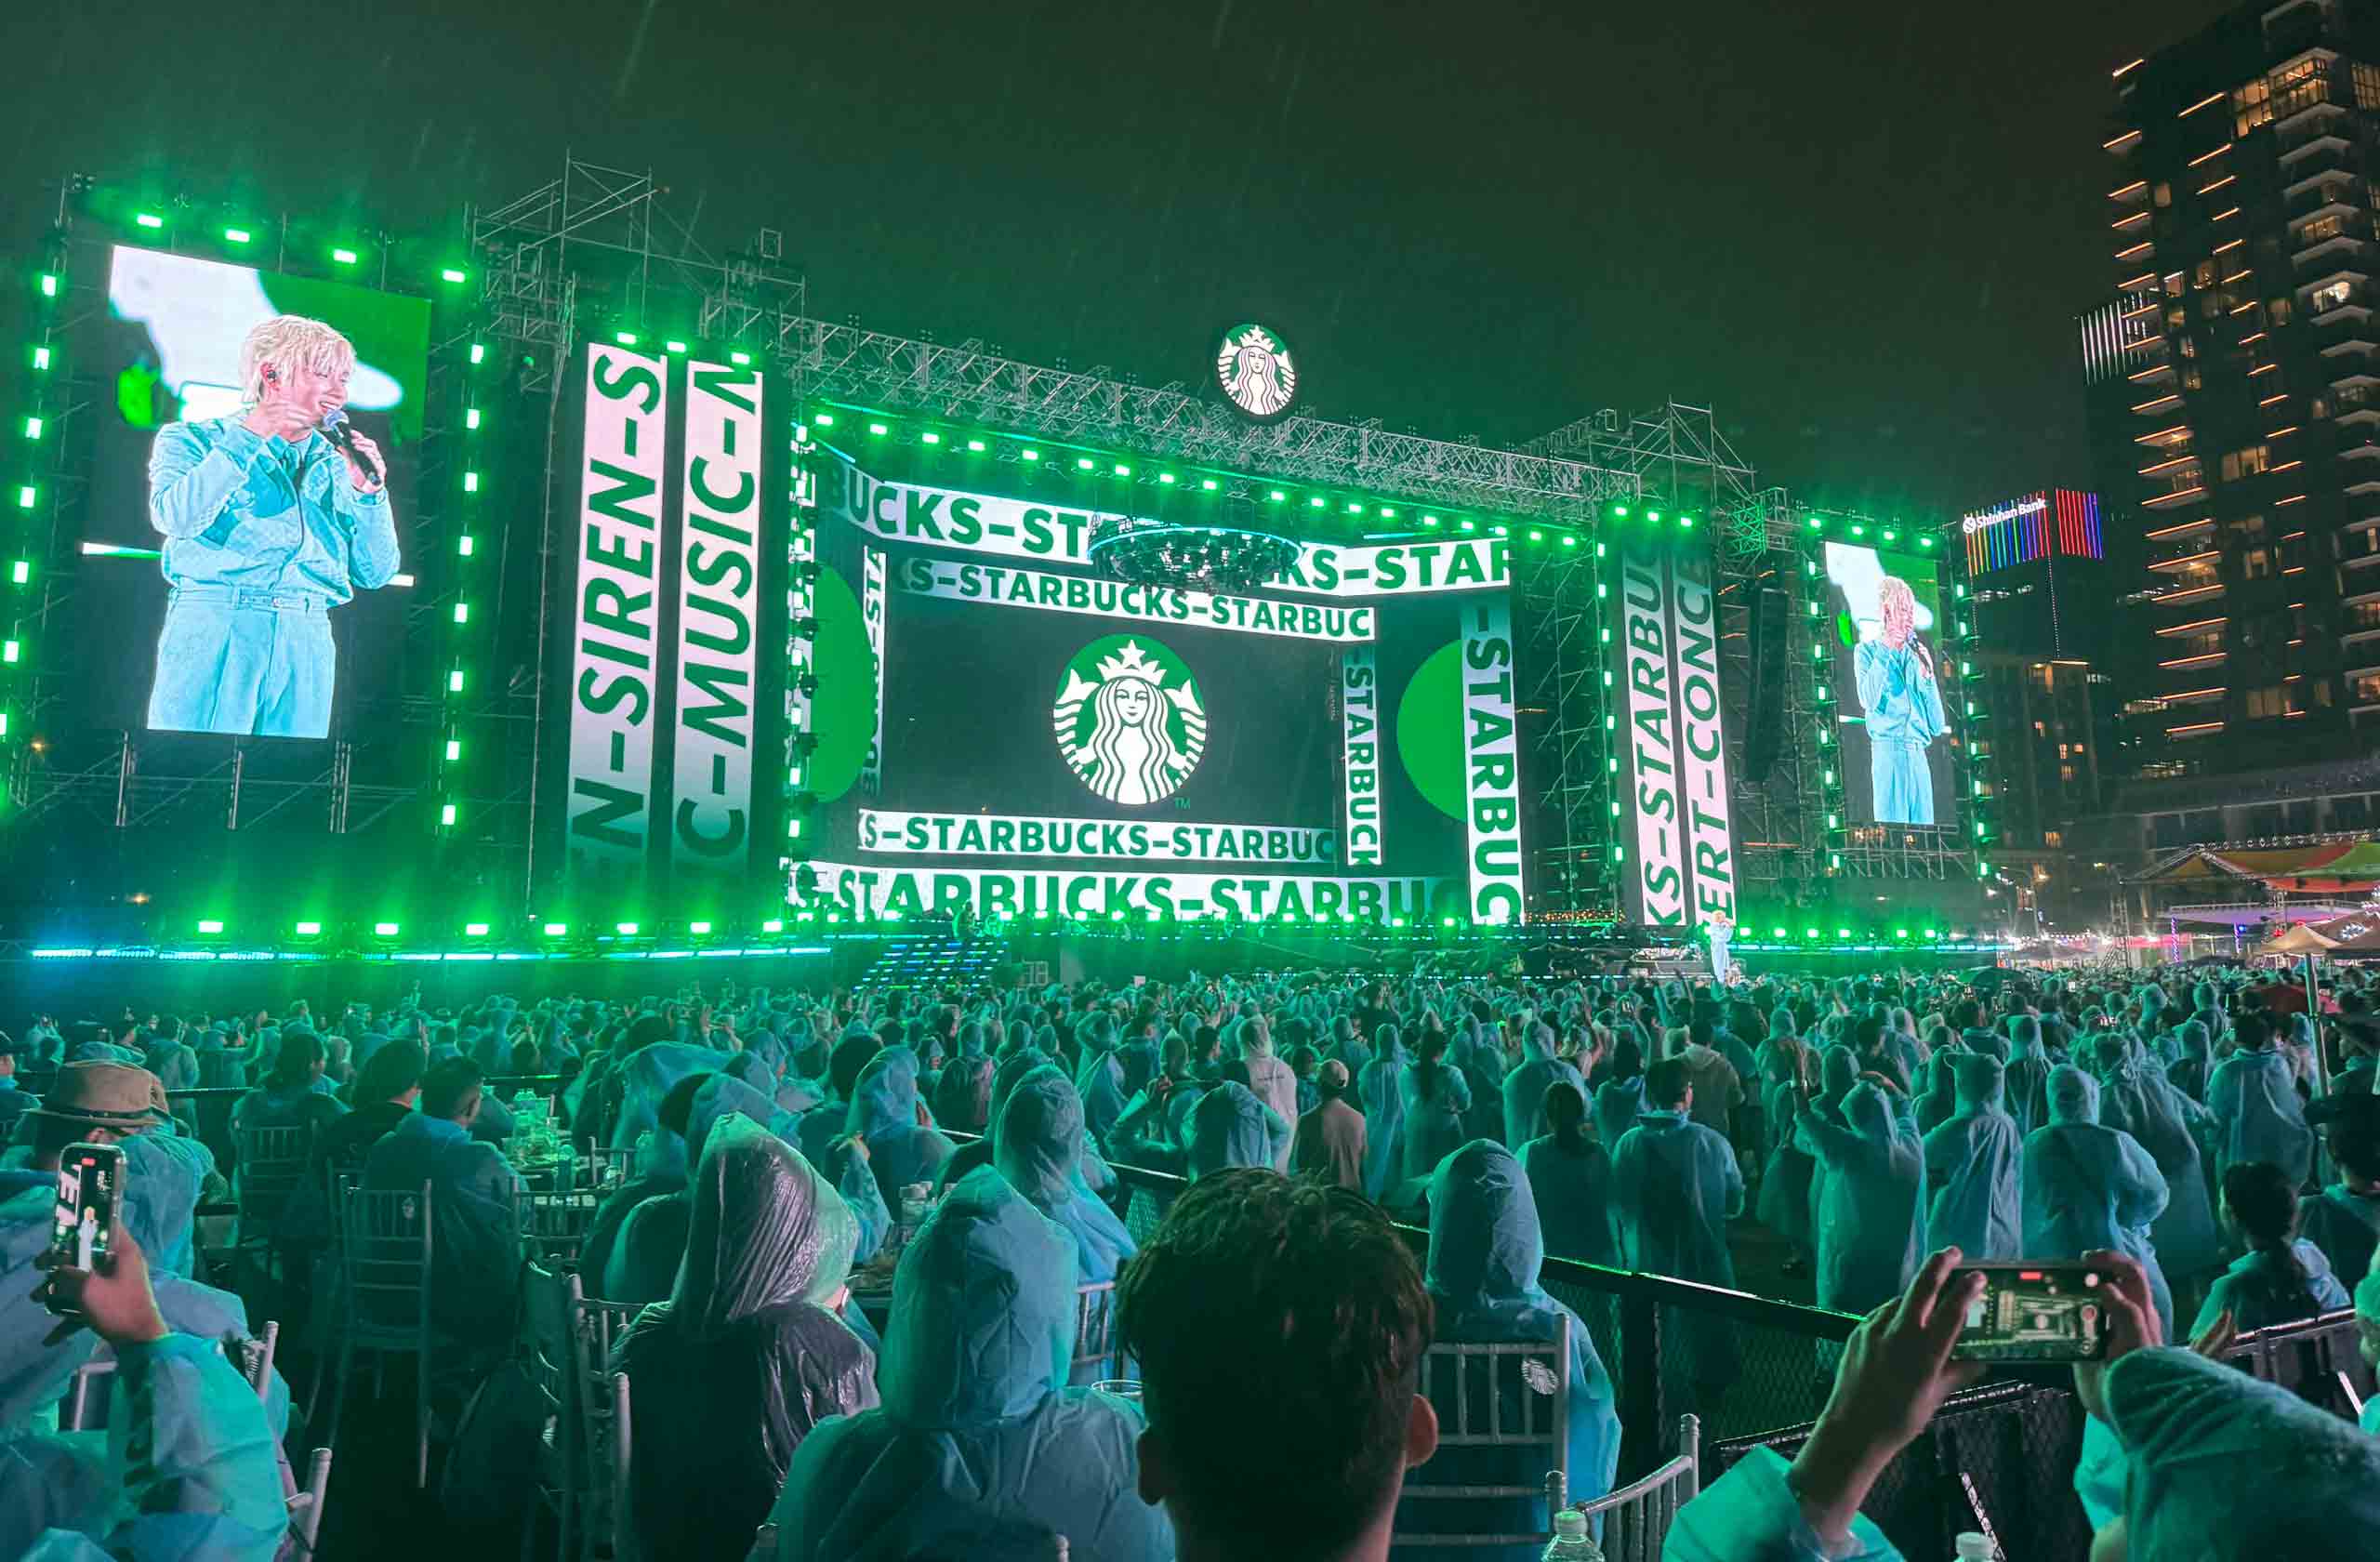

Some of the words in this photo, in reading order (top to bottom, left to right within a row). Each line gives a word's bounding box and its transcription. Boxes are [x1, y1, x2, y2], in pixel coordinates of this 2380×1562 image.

[1977, 507, 2018, 528] Shinhan
[2018, 498, 2046, 515] Bank
[1174, 797, 1191, 810] TM
